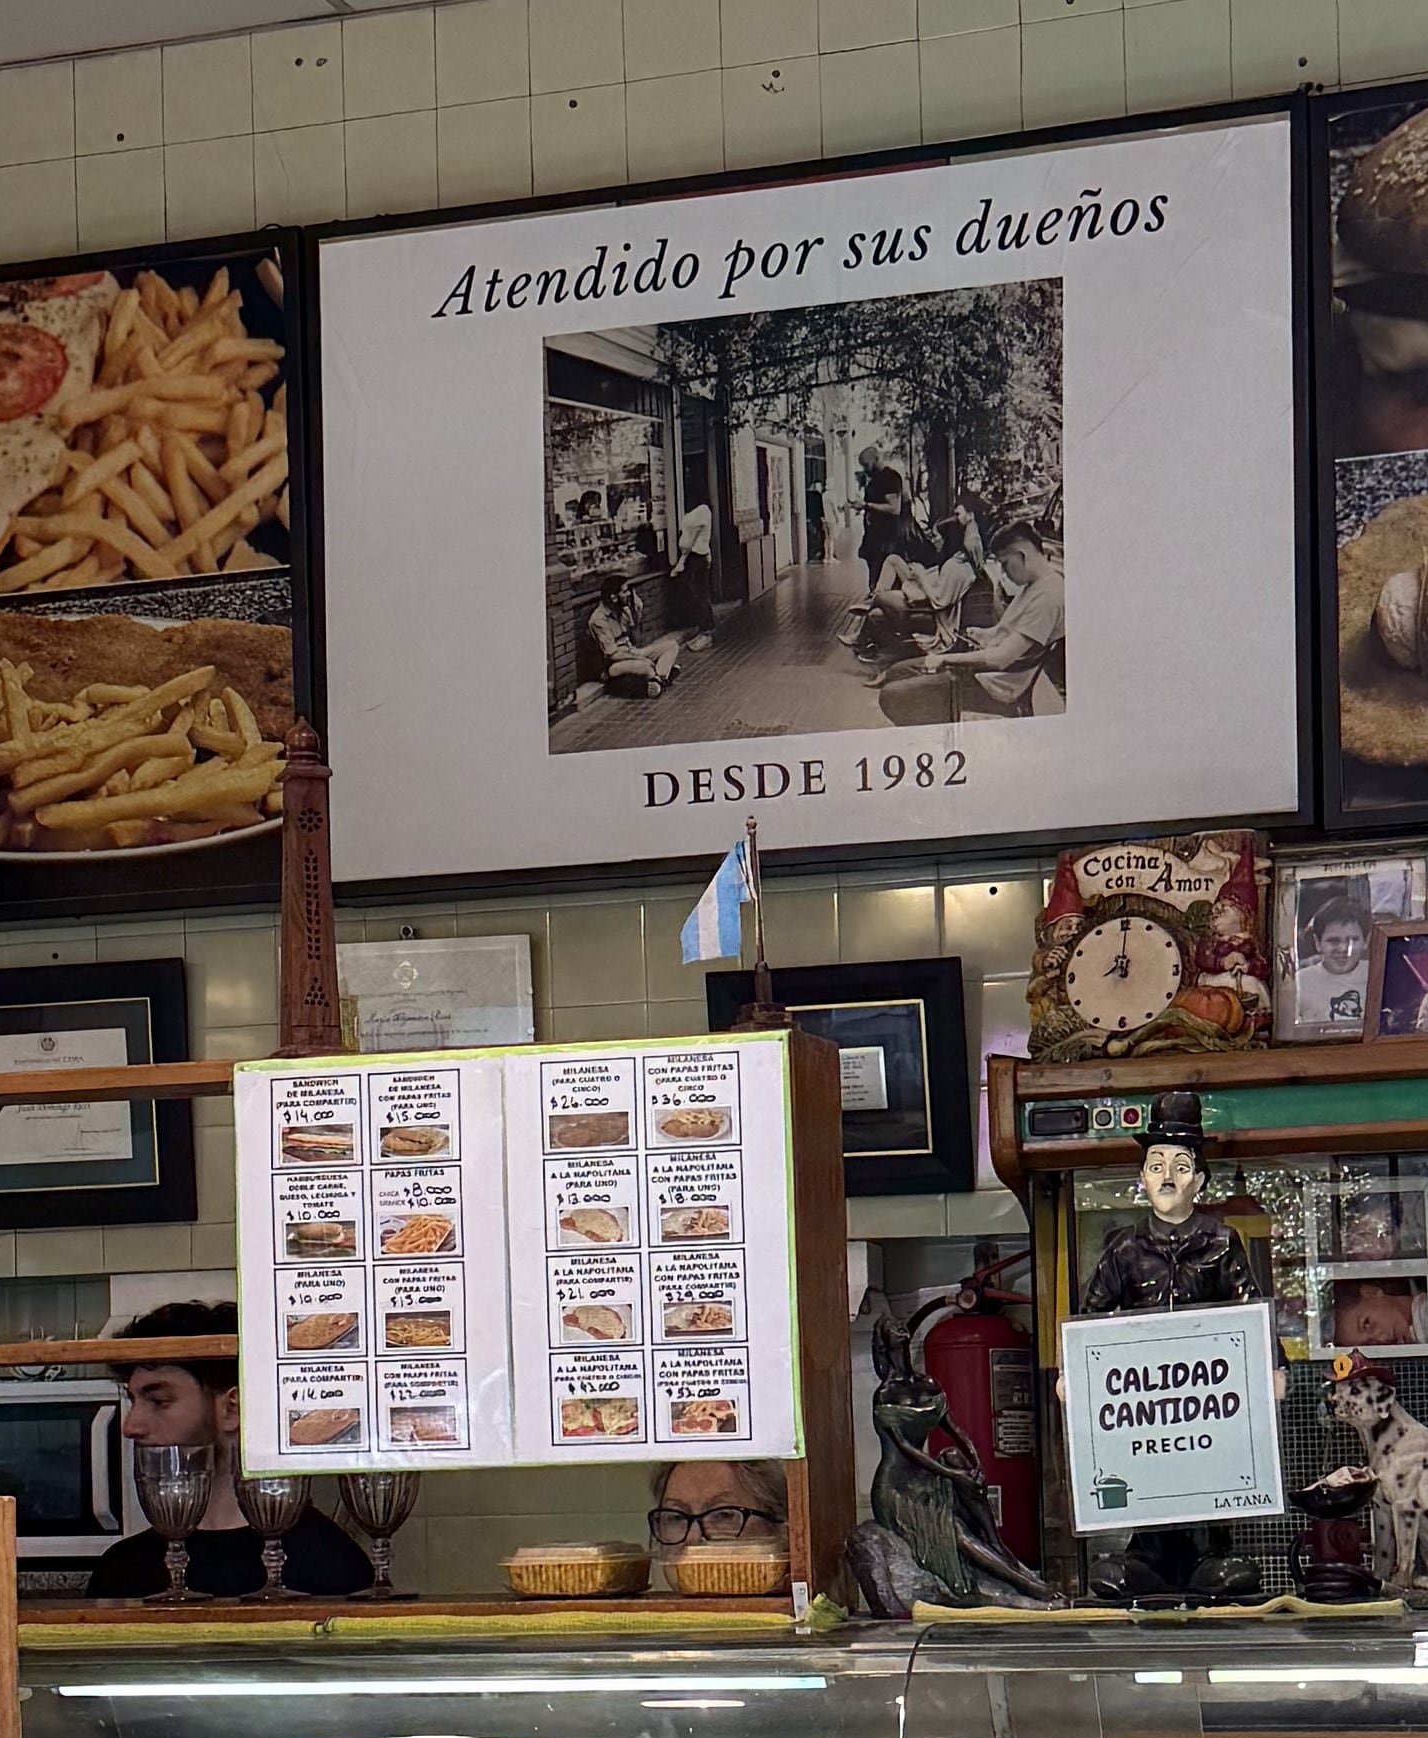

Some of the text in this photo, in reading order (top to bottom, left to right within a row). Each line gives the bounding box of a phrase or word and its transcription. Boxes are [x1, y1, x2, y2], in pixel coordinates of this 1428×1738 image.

[431, 188, 1170, 320] Atendido por sus dueños
[644, 751, 969, 808] DESDE 1982
[1084, 852, 1159, 876] Cocina
[1105, 862, 1214, 892] con Amor
[1172, 964, 1179, 976] 3
[1118, 1016, 1126, 1028] 6
[1106, 1358, 1228, 1396] CALIDAD
[1099, 1392, 1240, 1431] CANTIDAD
[1132, 1434, 1212, 1456] PRECIO
[1214, 1494, 1272, 1508] LA TANA
